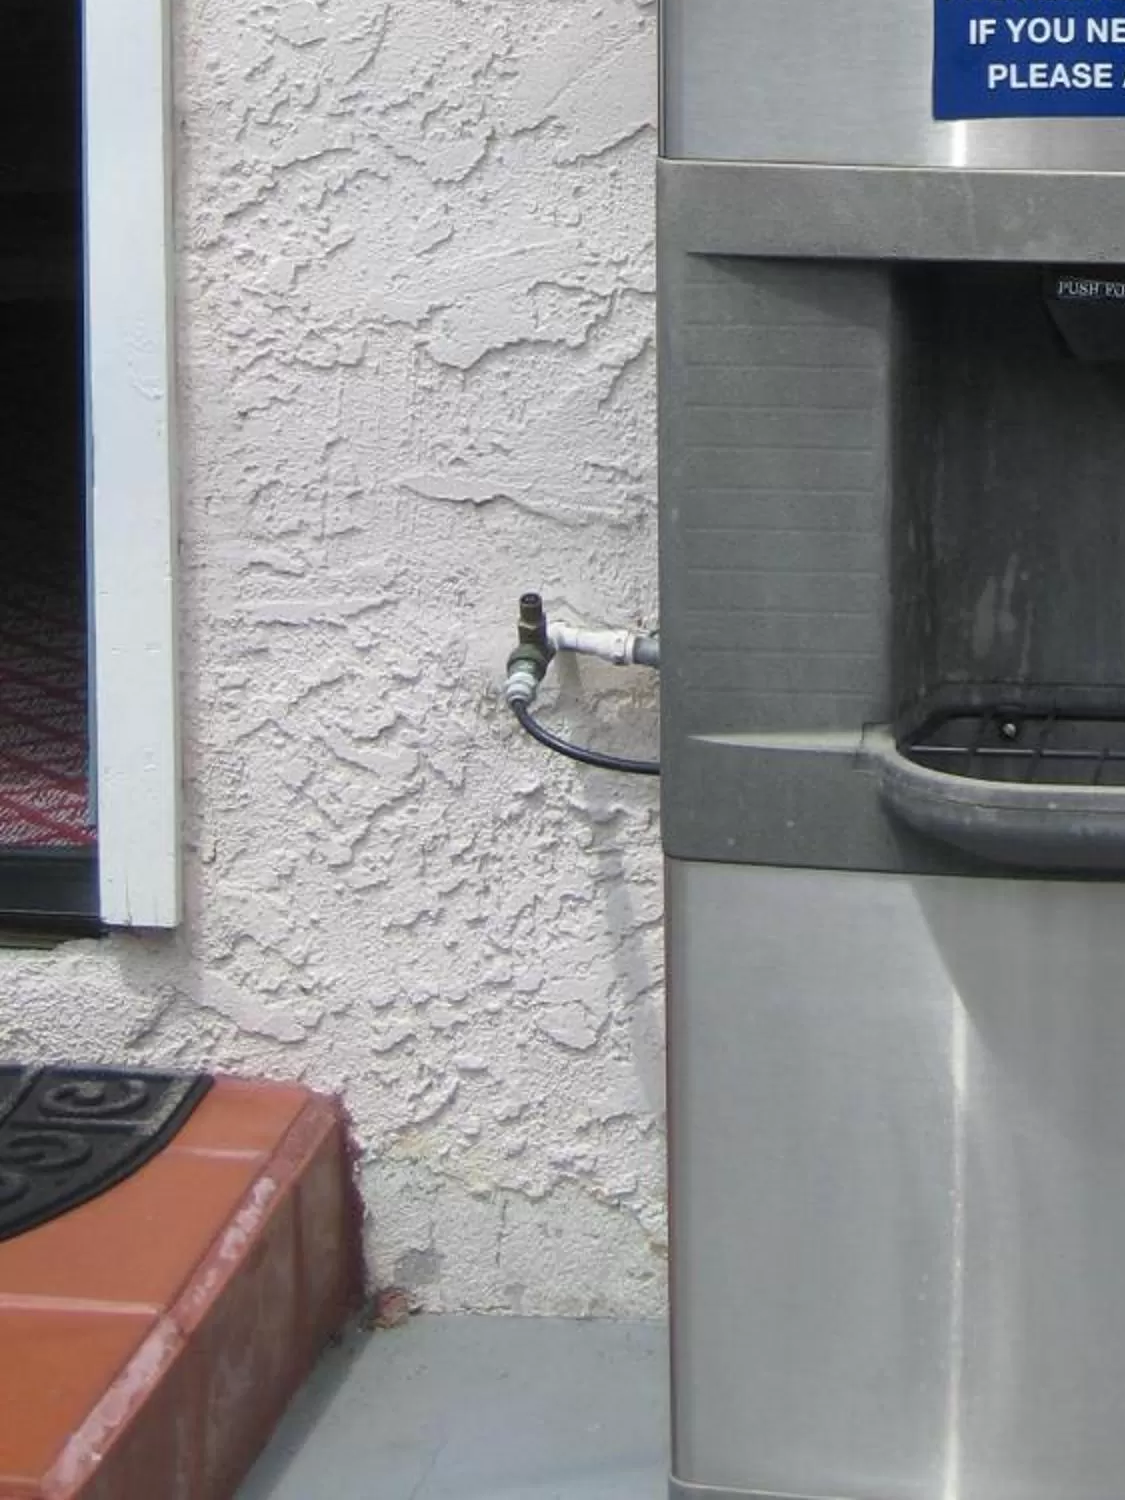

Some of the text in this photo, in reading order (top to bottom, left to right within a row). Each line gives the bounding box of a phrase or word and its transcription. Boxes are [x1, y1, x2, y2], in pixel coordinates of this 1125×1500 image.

[968, 18, 997, 45] IF
[1005, 17, 1075, 44] YOU
[987, 62, 1113, 89] PLEASE
[1058, 280, 1100, 297] PUSH
